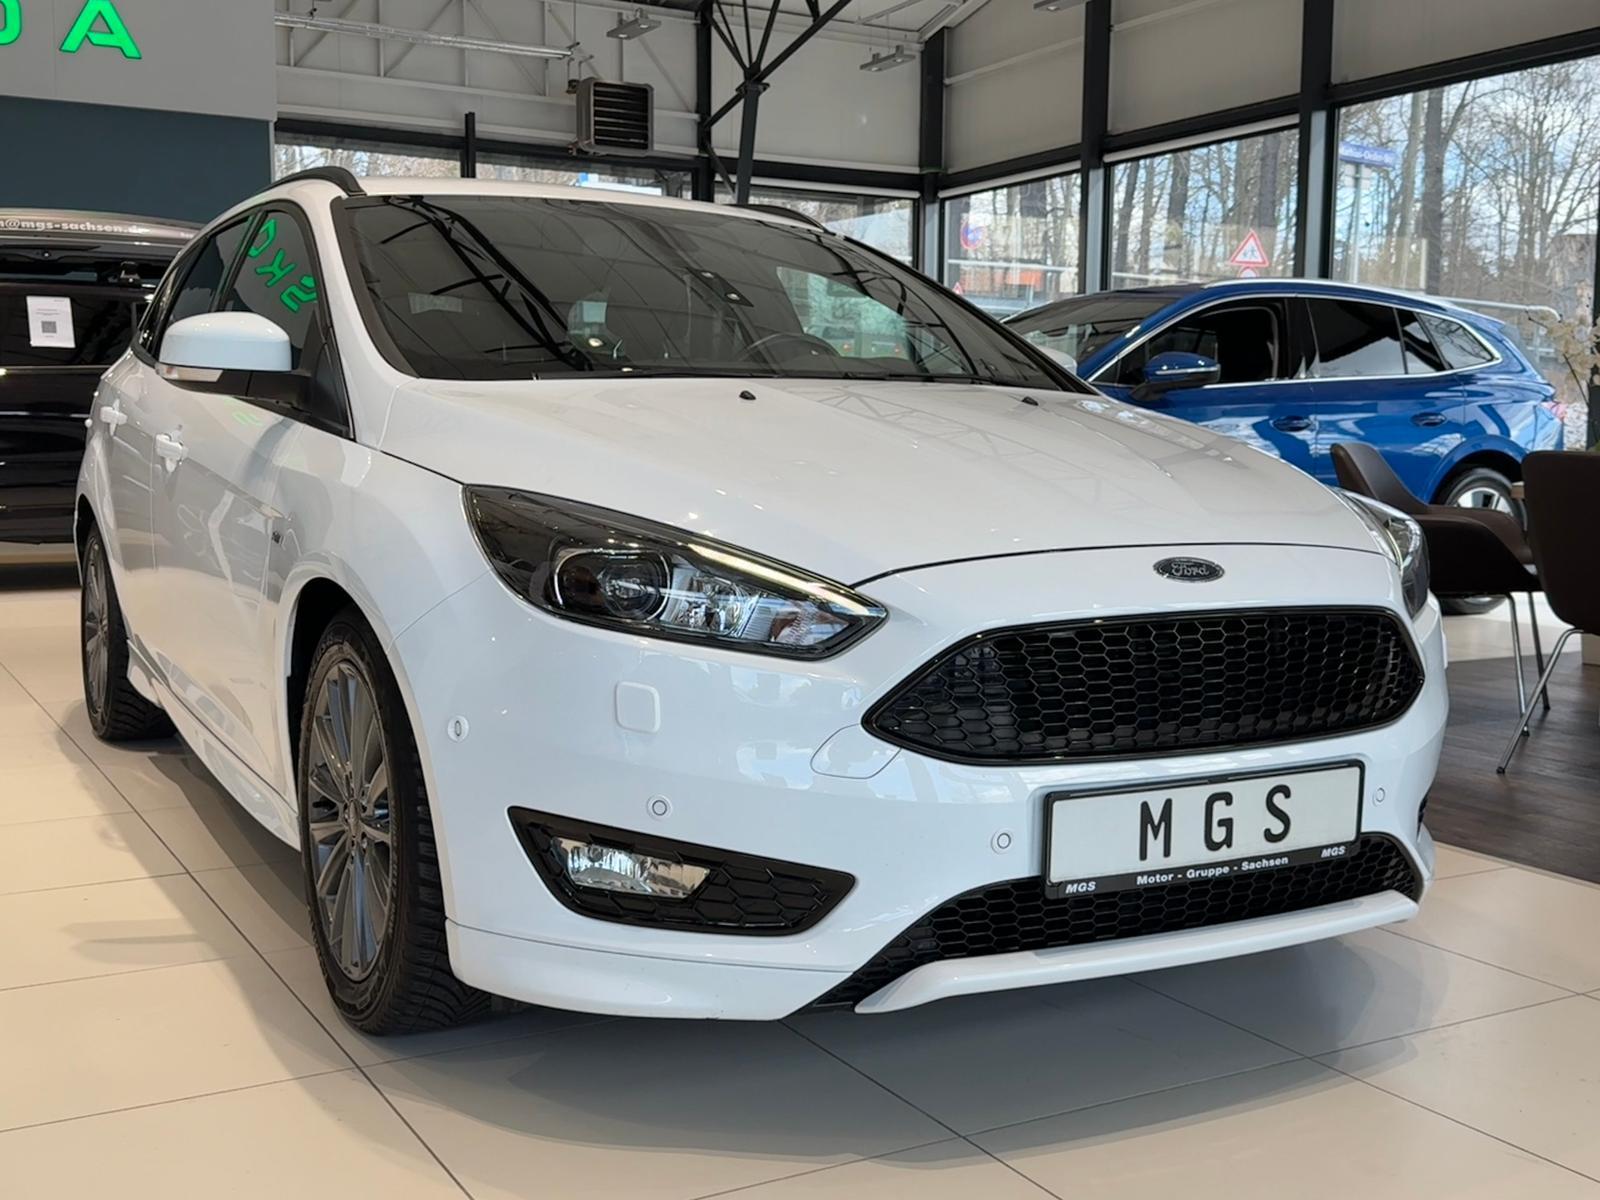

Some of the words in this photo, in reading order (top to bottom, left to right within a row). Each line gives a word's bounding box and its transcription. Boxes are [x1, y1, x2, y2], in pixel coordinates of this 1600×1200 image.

[0, 0, 142, 59] A
[1170, 561, 1210, 576] Ford
[1321, 846, 1346, 858] MGS
[1136, 872, 1174, 885] Motor
[1186, 865, 1230, 879] Gruppe
[1241, 857, 1289, 871] Sachsen
[1065, 881, 1097, 894] MGS
